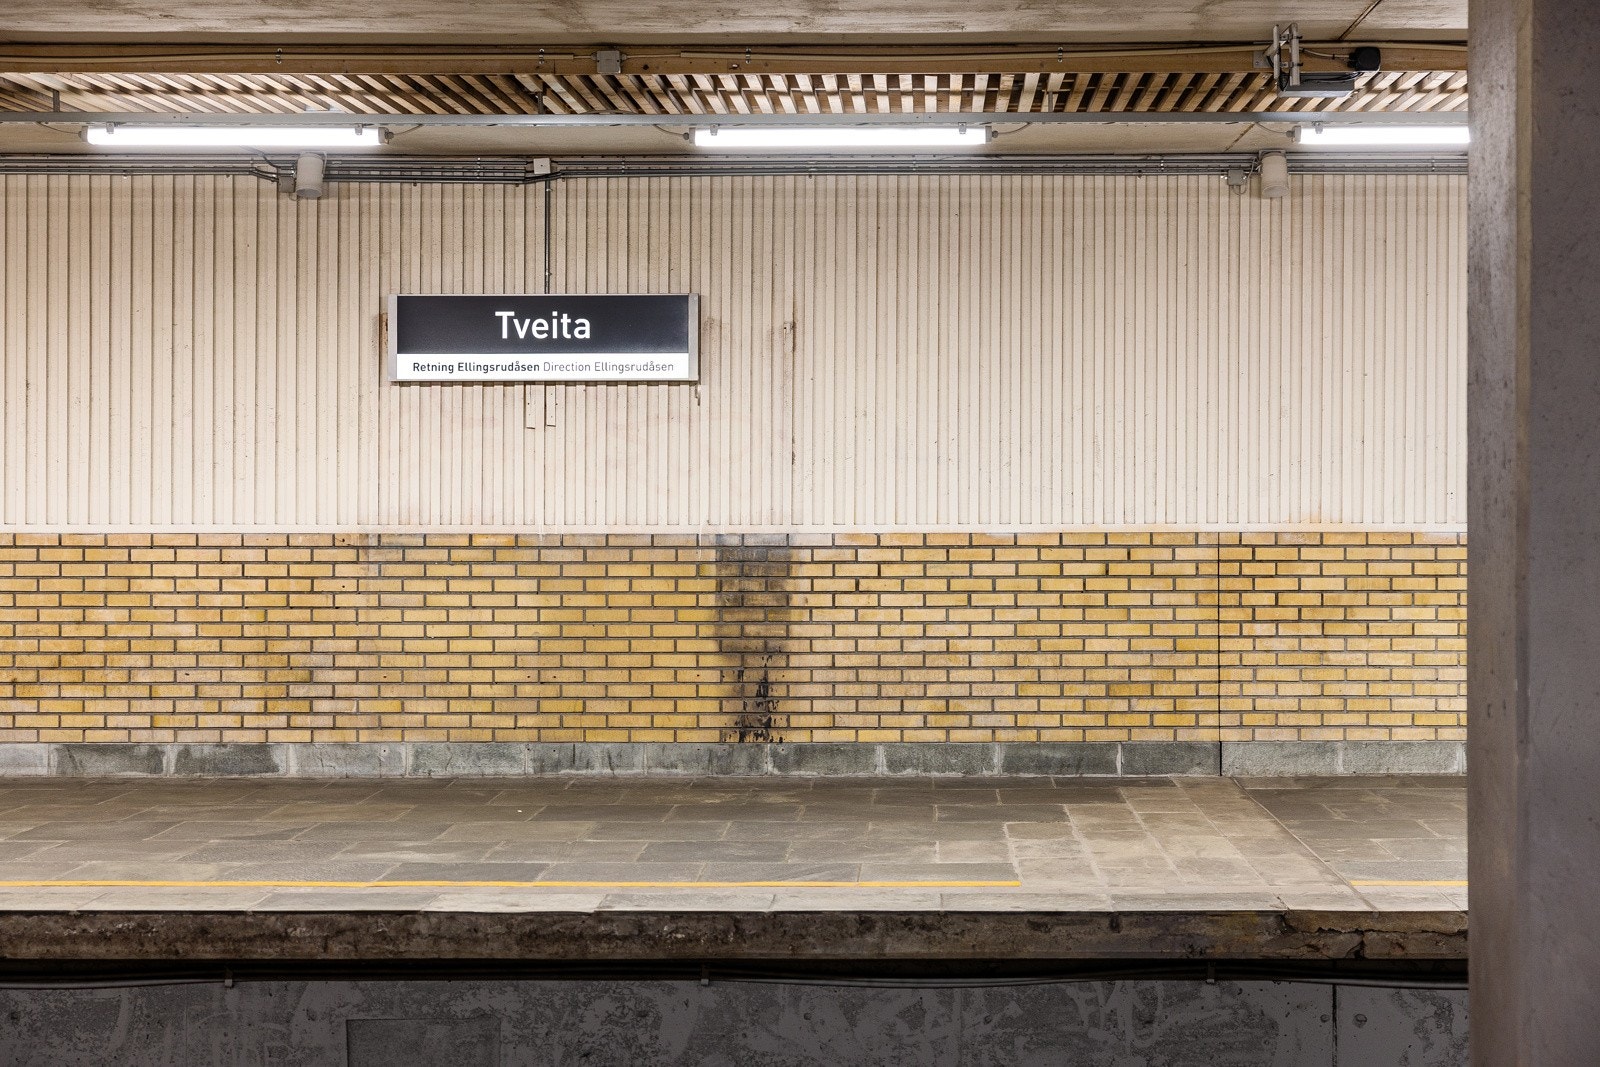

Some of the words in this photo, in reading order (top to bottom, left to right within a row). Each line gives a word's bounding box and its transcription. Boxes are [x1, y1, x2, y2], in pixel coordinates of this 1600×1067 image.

[494, 310, 591, 340] Tveita
[412, 361, 454, 374] Retning
[457, 360, 540, 374] Ellingsrudåsen
[543, 361, 591, 373] Direction
[594, 360, 674, 374] Ellingsrudåsen
